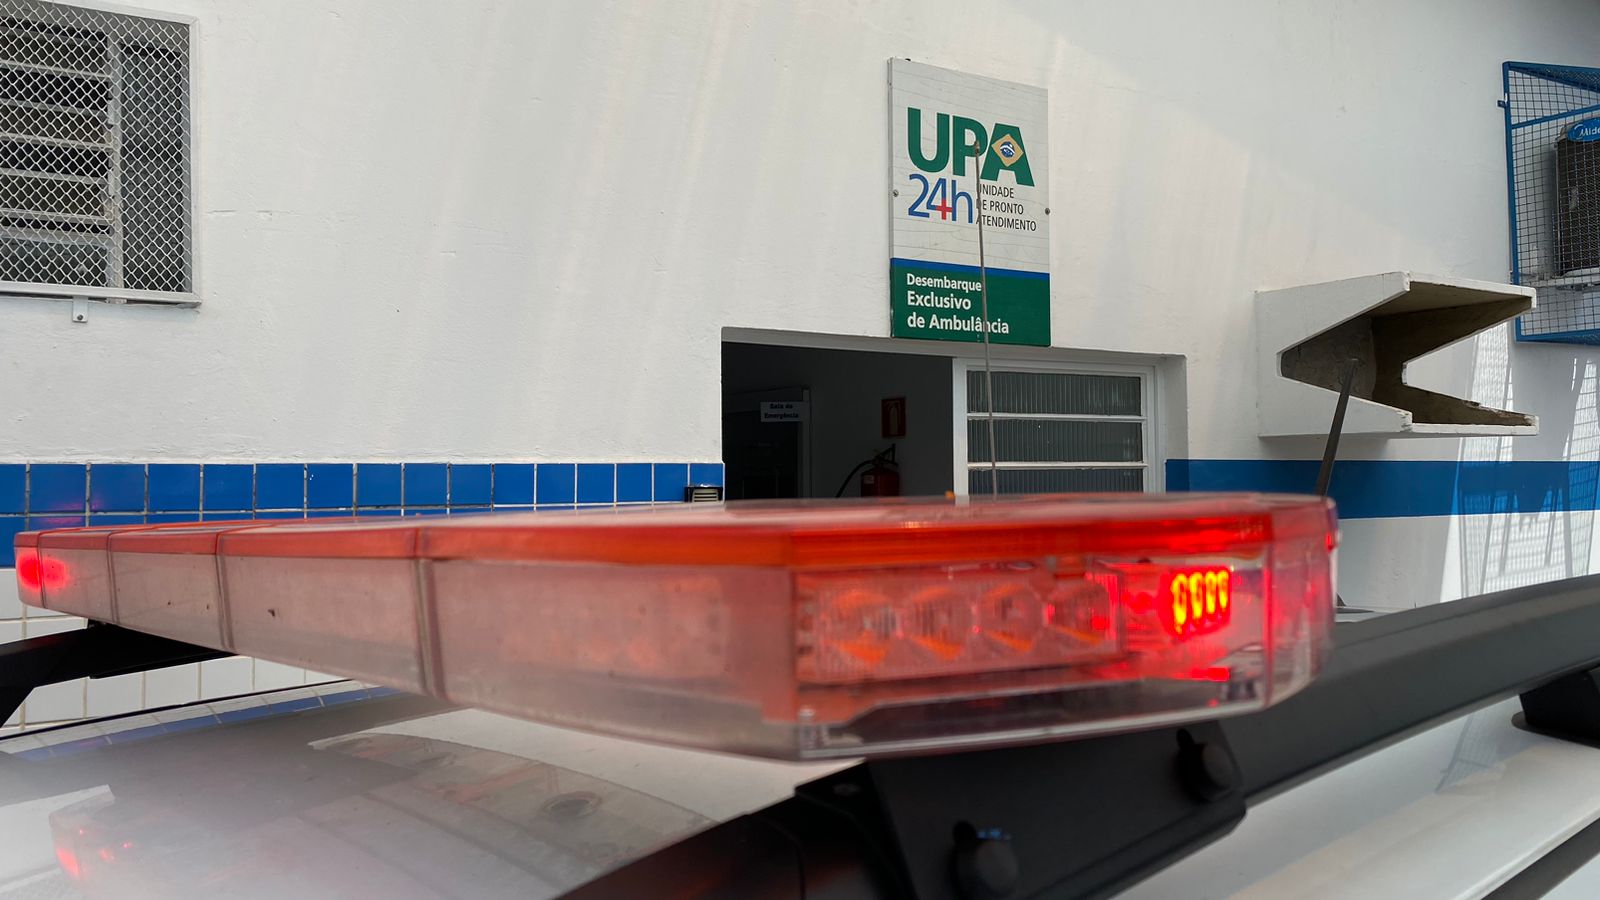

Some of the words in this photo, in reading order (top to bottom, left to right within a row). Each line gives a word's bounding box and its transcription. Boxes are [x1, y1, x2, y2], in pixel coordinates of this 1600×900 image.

[907, 106, 1035, 187] UPA
[908, 173, 973, 224] 24h
[976, 198, 987, 211] E
[990, 200, 1024, 215] PRONTO
[976, 213, 1037, 231] TENDIMENTO
[906, 273, 982, 293] Desembarque
[907, 290, 972, 310] Exclusivo
[907, 312, 925, 328] de
[929, 313, 1010, 334] Ambulância
